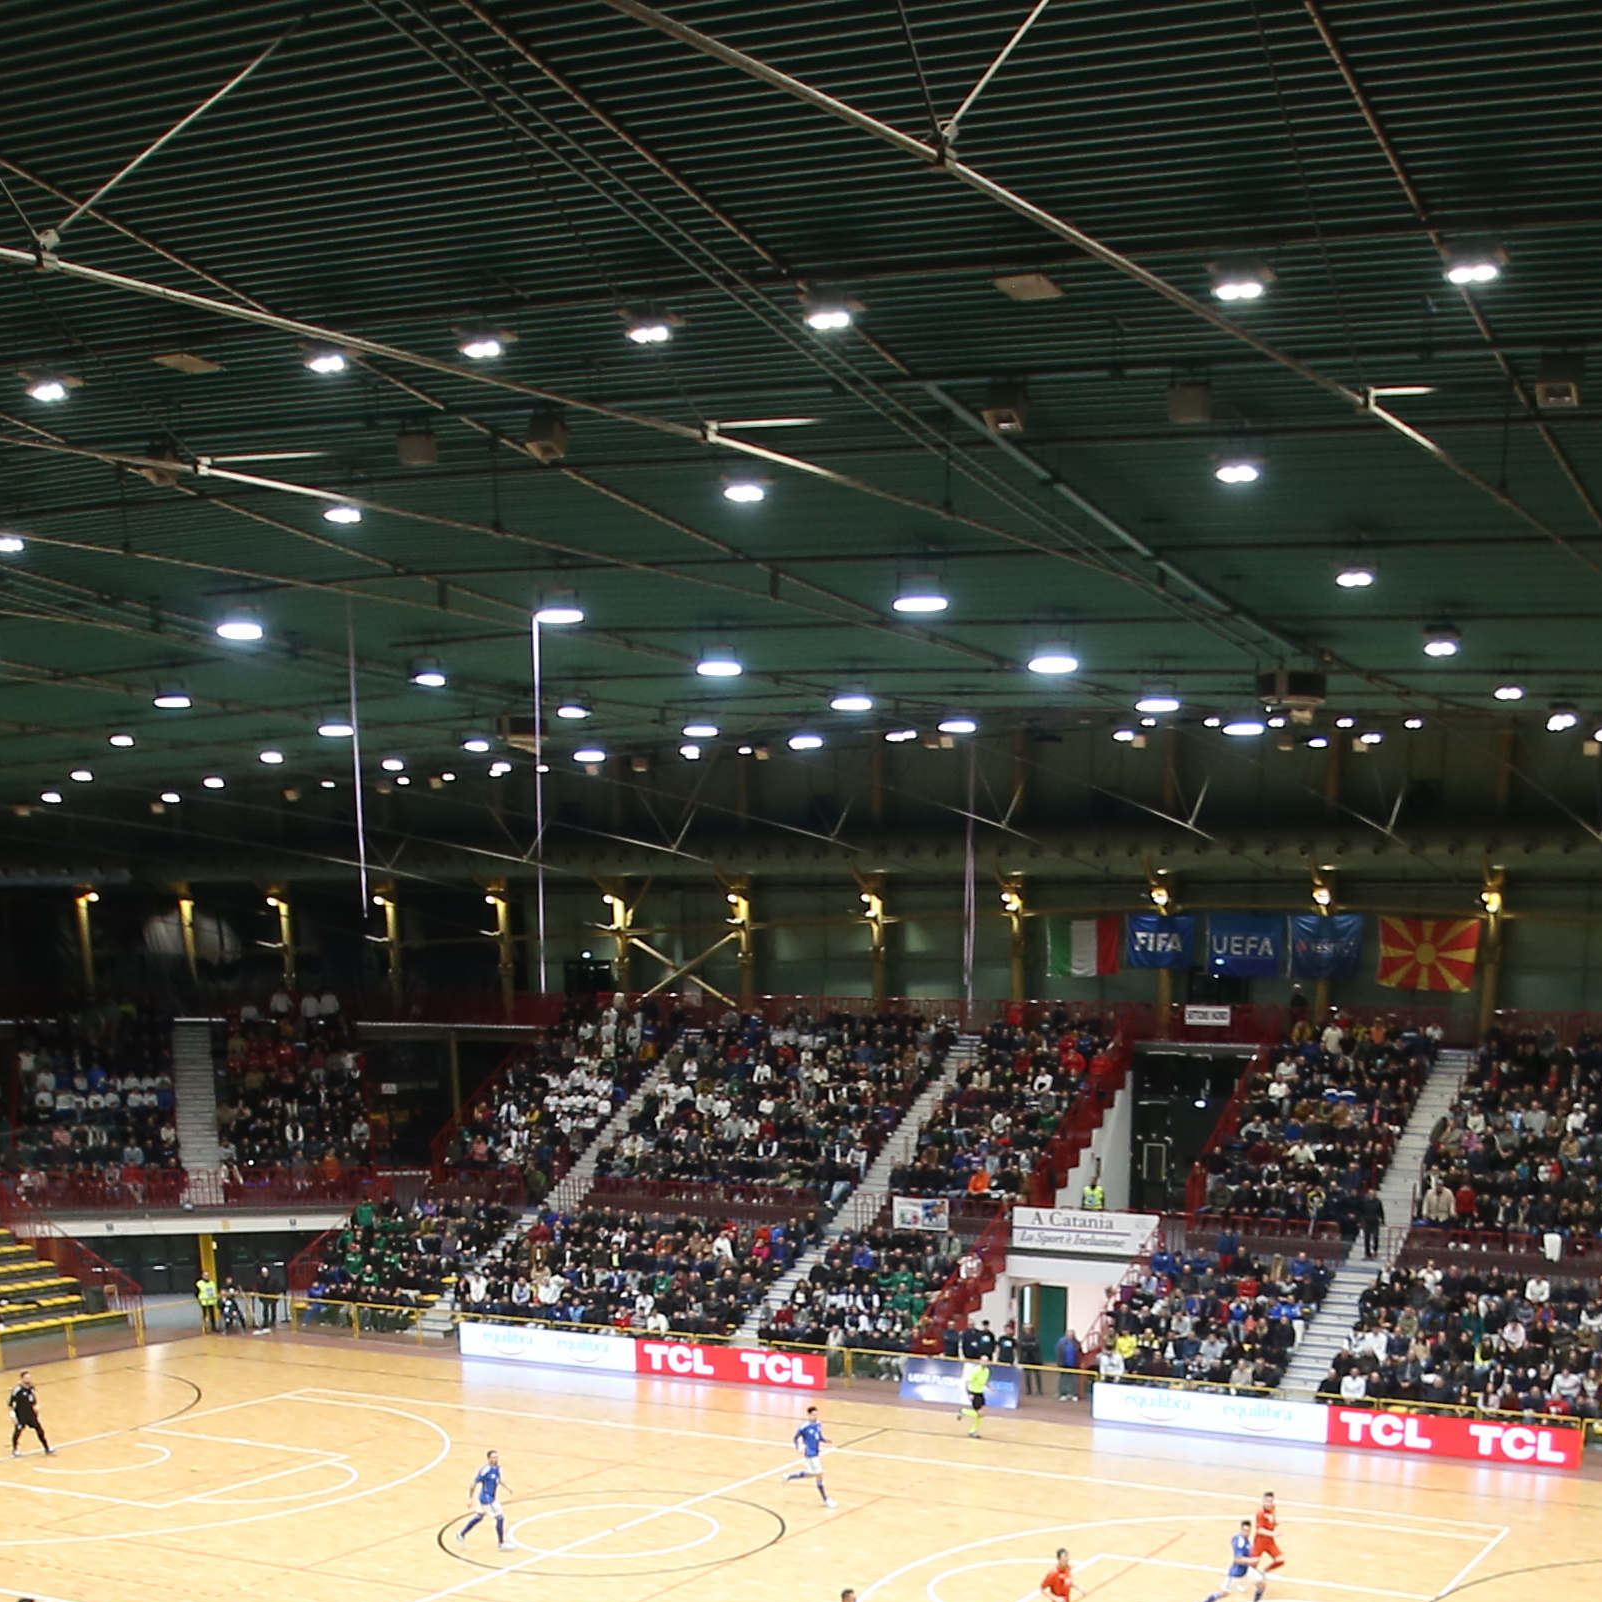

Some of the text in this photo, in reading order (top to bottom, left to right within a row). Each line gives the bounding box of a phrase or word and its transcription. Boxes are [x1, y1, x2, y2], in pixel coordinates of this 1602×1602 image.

[1134, 931, 1182, 952] FIFA
[1212, 935, 1274, 957] UEFA
[1031, 1211, 1114, 1229] A Catania
[1036, 1232, 1065, 1246] Sport
[644, 1343, 814, 1385] TCL TCL
[1124, 1390, 1293, 1424] equilibra equilibra
[1340, 1411, 1565, 1464] TCL TCL
